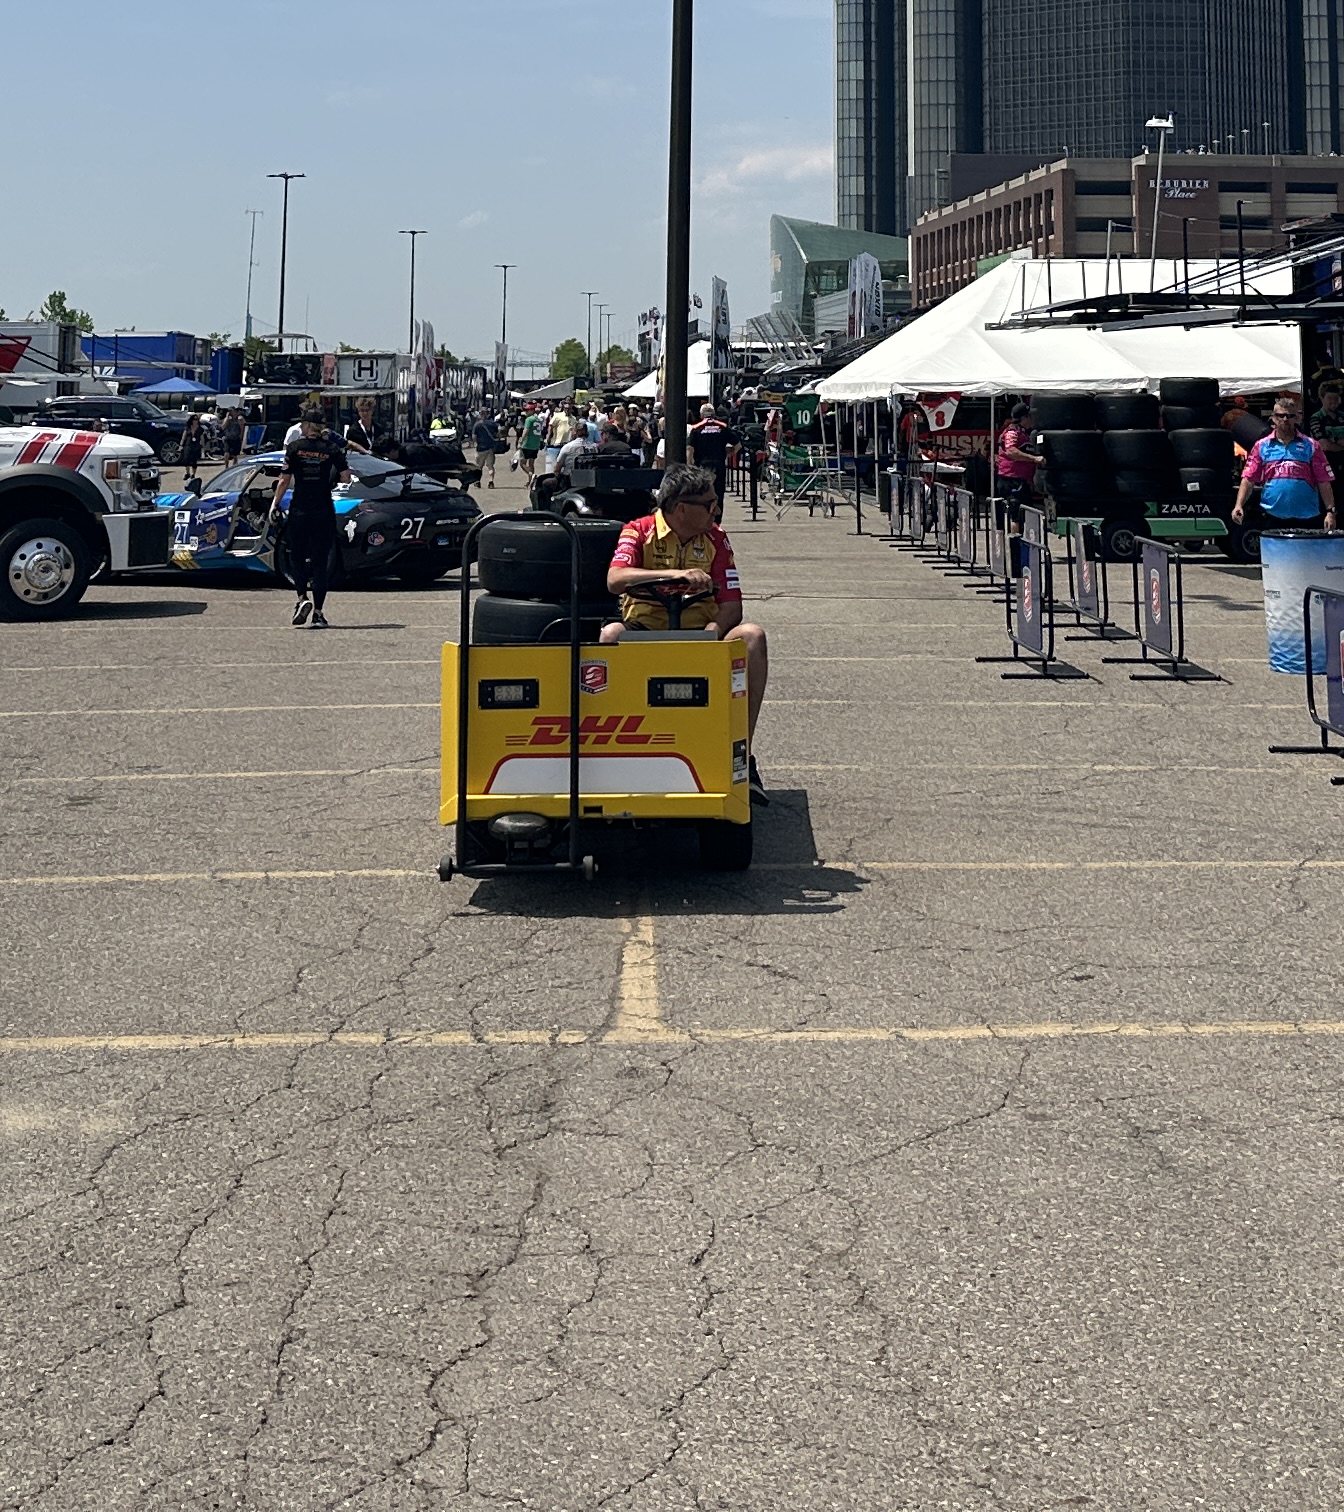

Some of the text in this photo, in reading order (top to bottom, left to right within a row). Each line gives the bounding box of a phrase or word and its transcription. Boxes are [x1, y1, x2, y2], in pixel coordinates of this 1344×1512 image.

[796, 409, 811, 425] 10
[934, 410, 946, 428] 8
[936, 434, 990, 457] HUSK
[1161, 504, 1211, 514] ZAPATA
[174, 522, 190, 543] 27
[401, 517, 425, 540] 27
[529, 714, 653, 746] DHL
